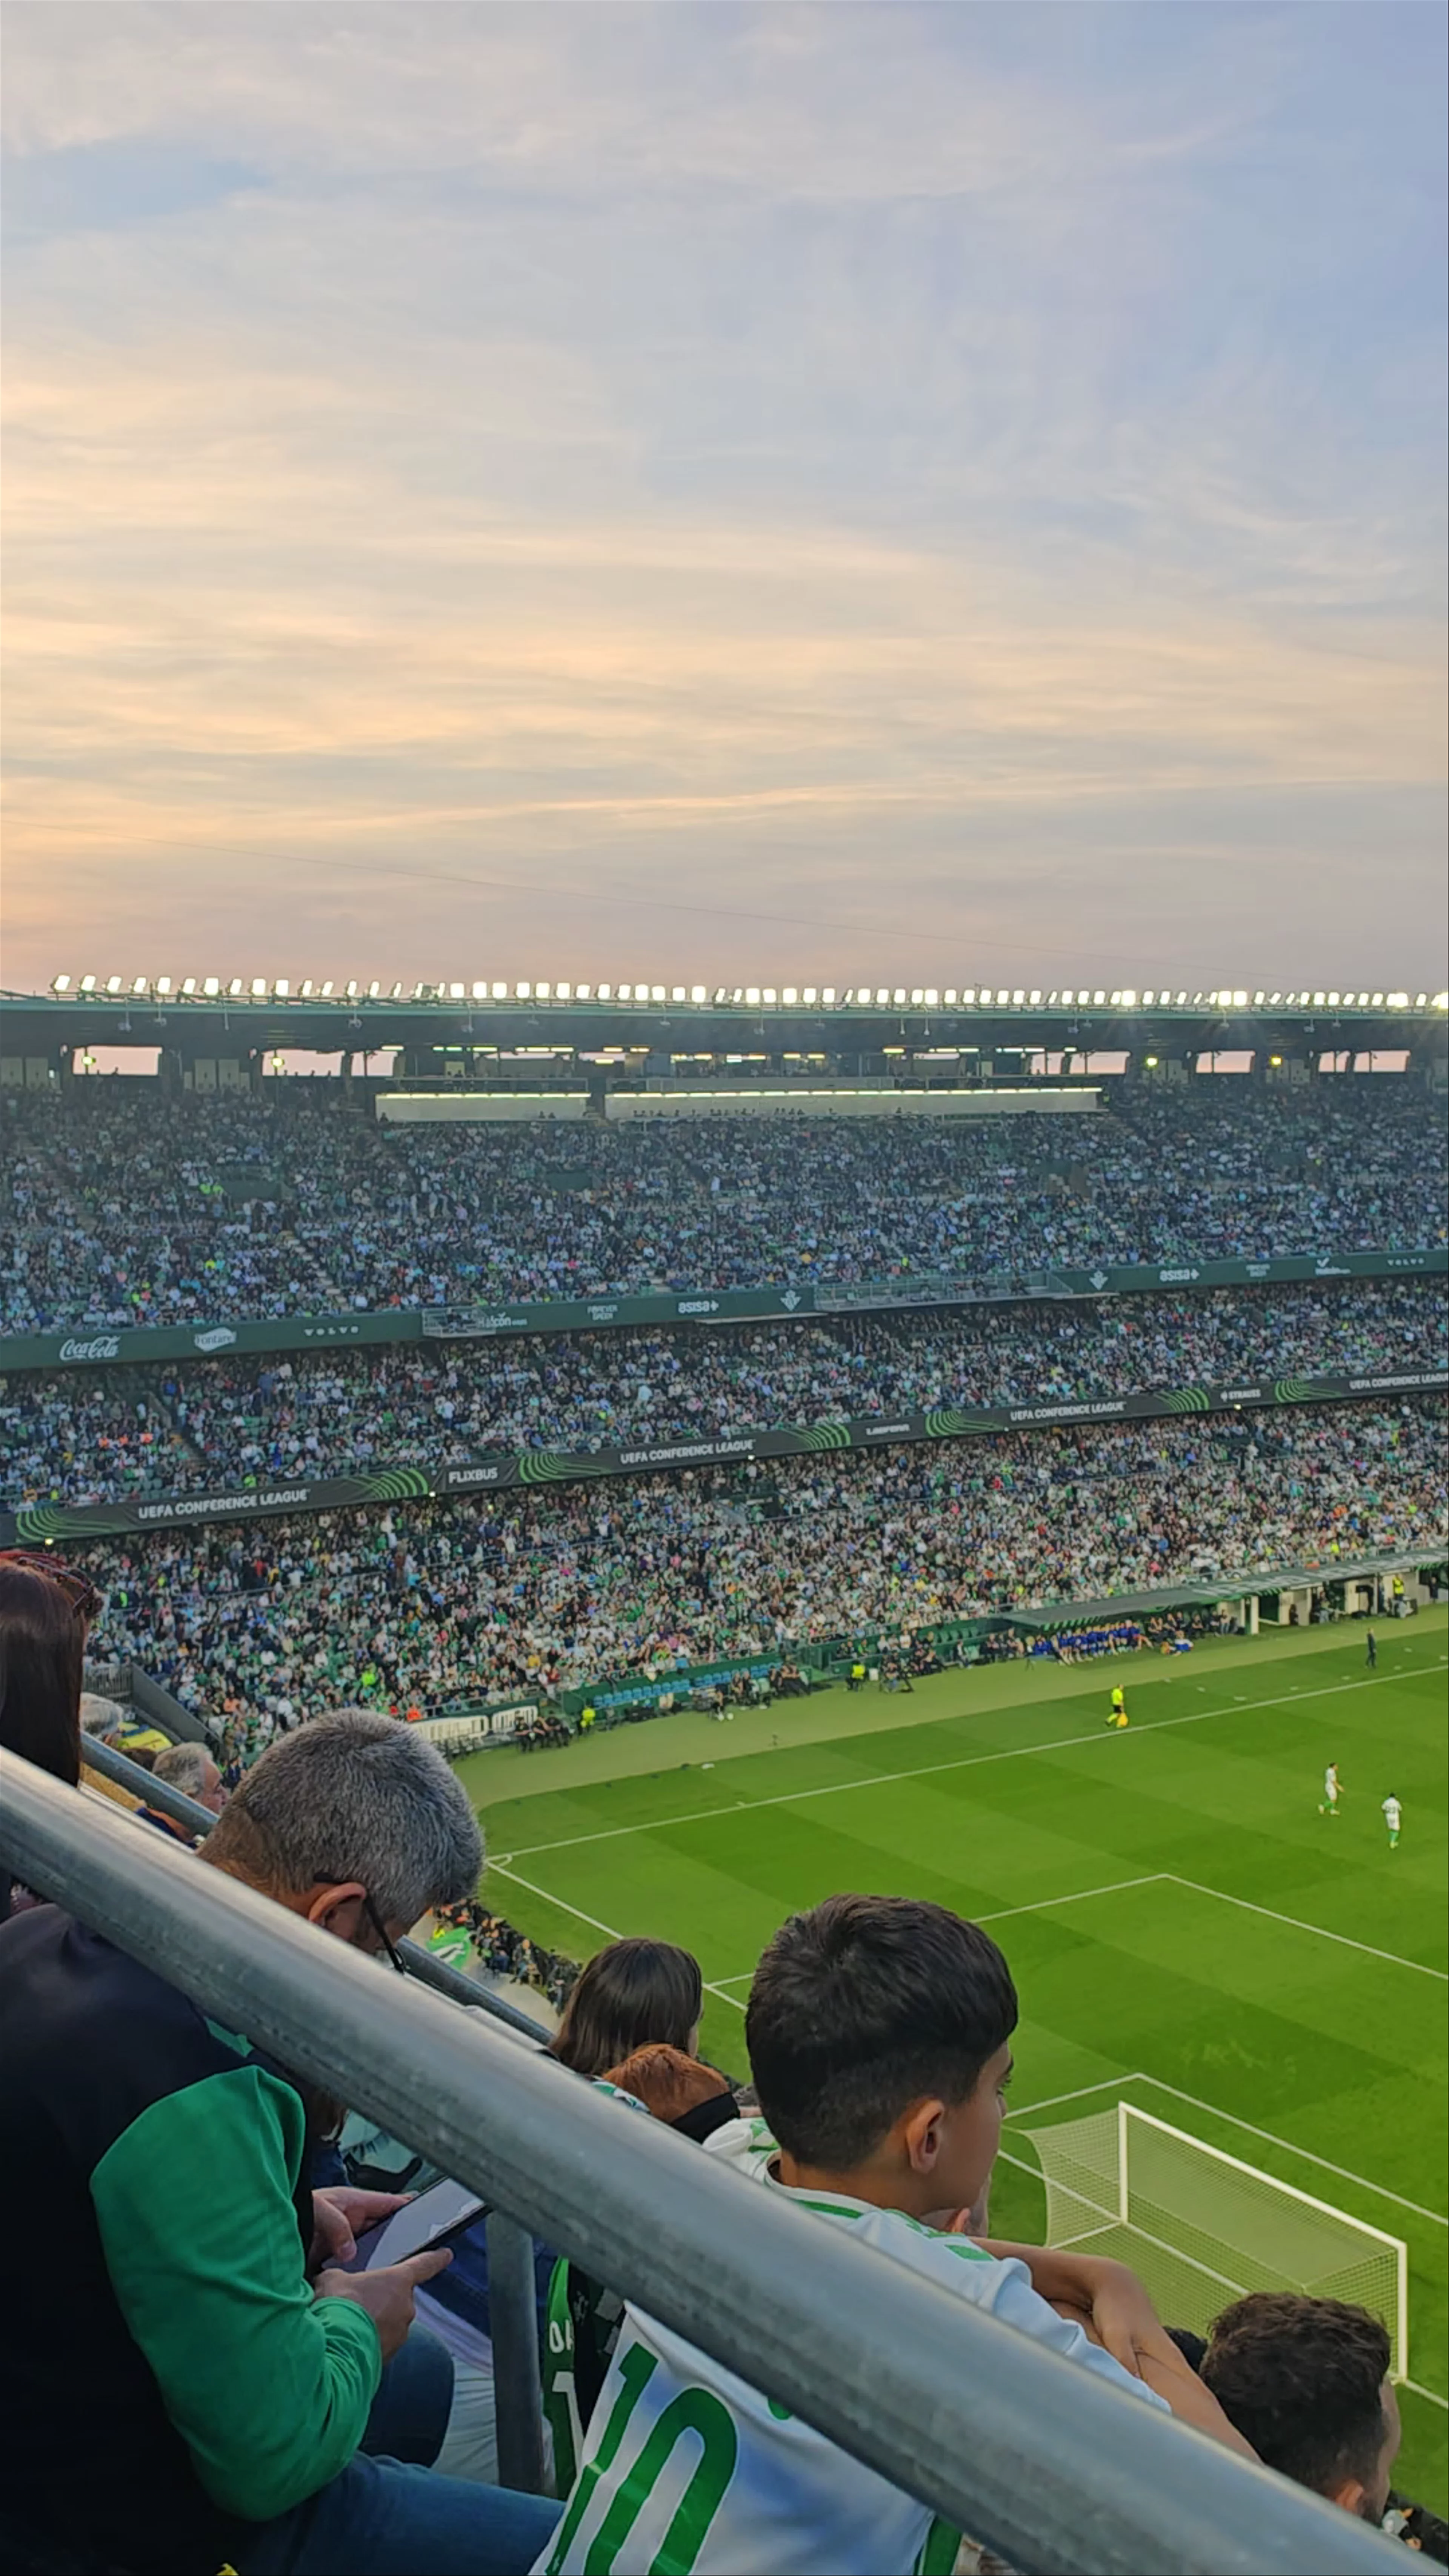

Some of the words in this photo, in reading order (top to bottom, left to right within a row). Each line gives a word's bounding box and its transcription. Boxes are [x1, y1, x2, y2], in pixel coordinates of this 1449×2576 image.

[304, 1326, 359, 1337] VOLVO
[1010, 1409, 1034, 1421] UEFA
[1035, 1404, 1090, 1418] CONFERENCE
[620, 1452, 648, 1464] UEFA
[649, 1444, 713, 1460] CONFERENCE
[715, 1439, 753, 1453] LEAGUE
[449, 1467, 498, 1484] FLIXBUS
[138, 1504, 173, 1519] UEFA
[175, 1495, 257, 1515] CONFERENCE
[259, 1488, 308, 1505] LEAGUE
[544, 2341, 739, 2576] 10
